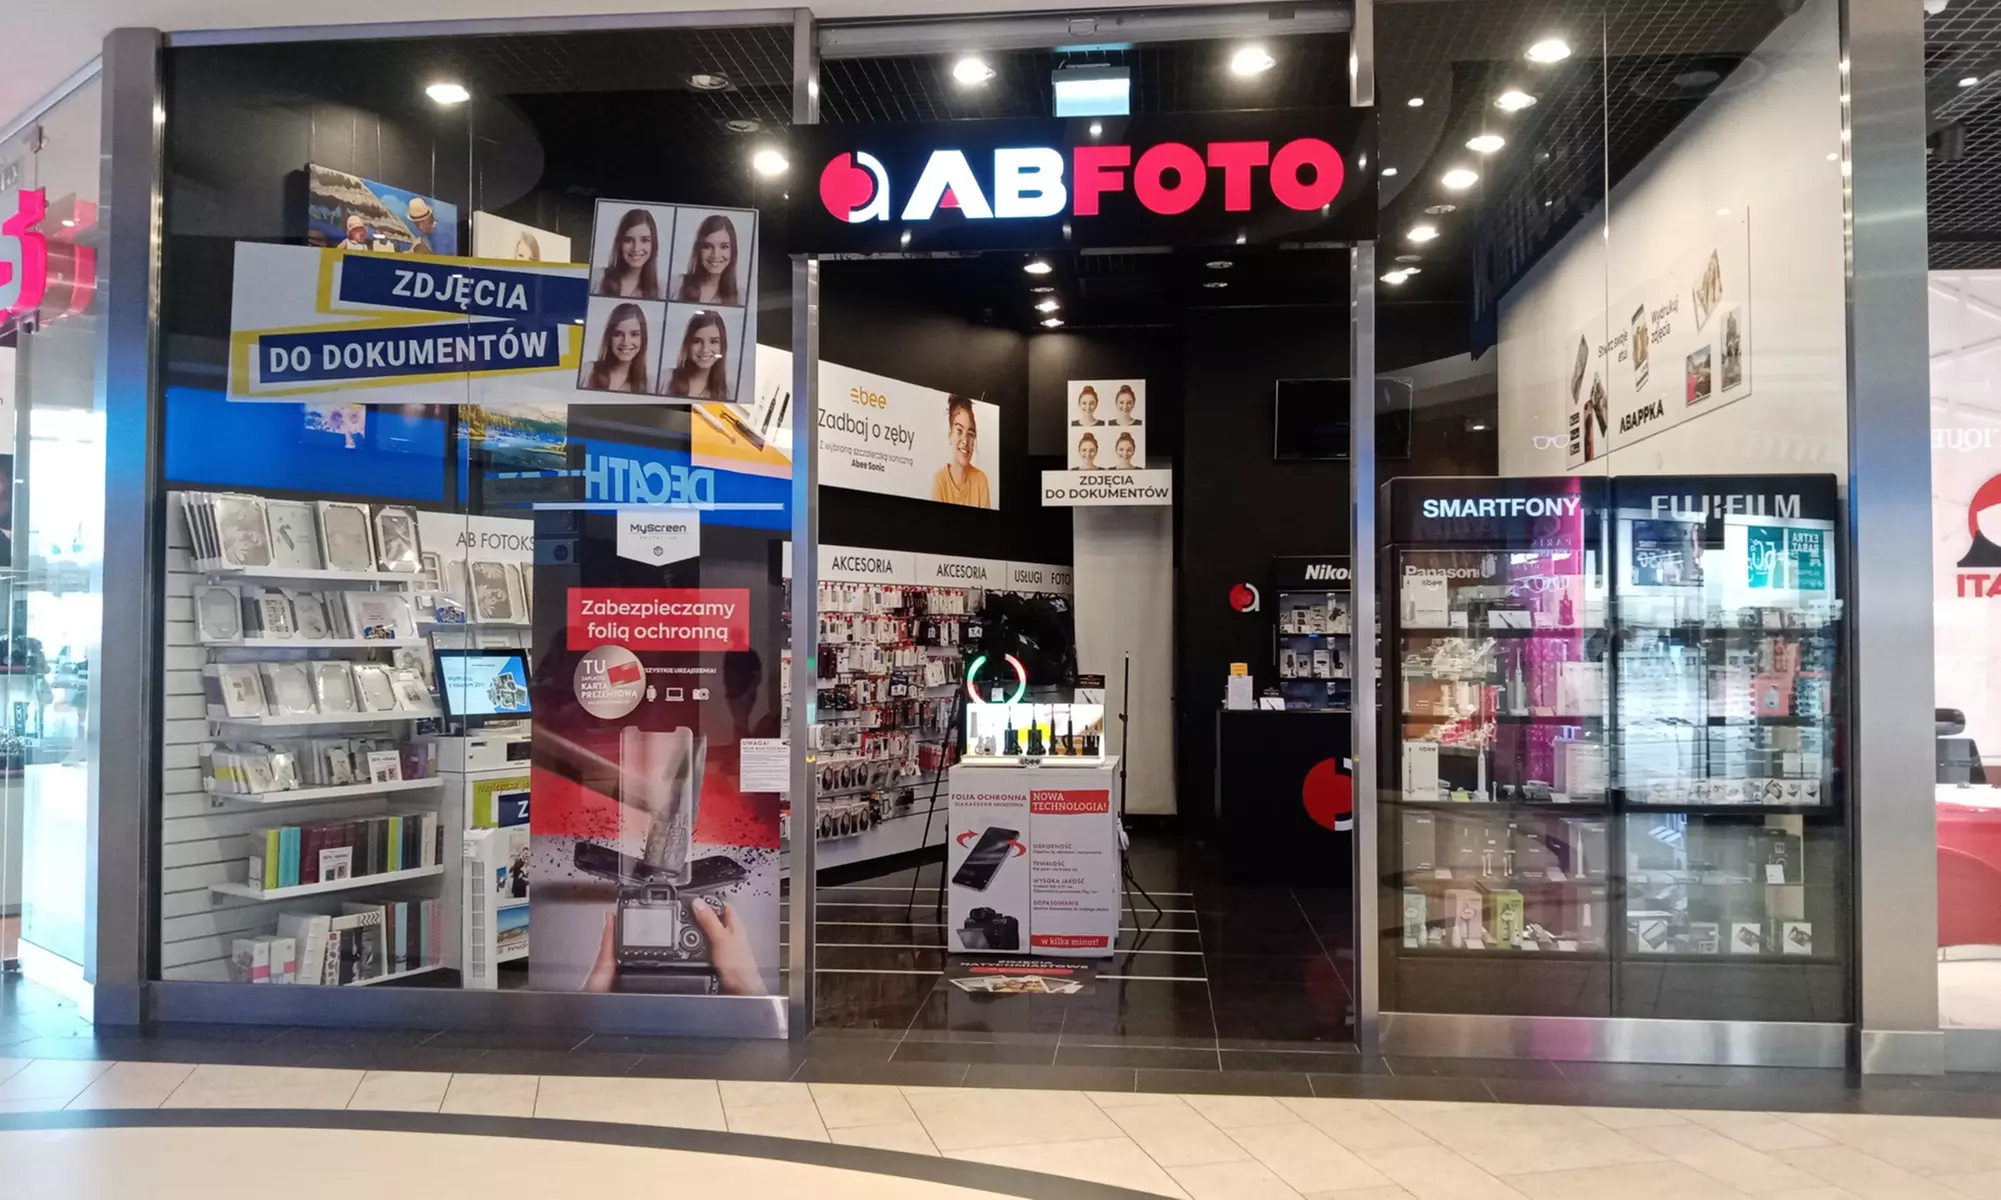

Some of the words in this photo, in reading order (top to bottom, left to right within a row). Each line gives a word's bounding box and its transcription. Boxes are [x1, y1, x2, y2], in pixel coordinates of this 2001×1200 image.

[901, 138, 1344, 220] ABFOTO
[392, 269, 528, 311] ZDJĘCIA
[270, 345, 311, 373] DO
[323, 330, 548, 370] DOKUMENTÓW
[818, 408, 868, 442] Zadbaj
[872, 423, 881, 438] o
[884, 424, 915, 450] zęby
[852, 459, 867, 470] Abee
[869, 461, 885, 472] Sonic
[1079, 475, 1134, 488] ZDJĘCIA
[1045, 488, 1065, 499] DO
[1068, 485, 1169, 499] DOKUMENTÓW
[1422, 498, 1581, 518] SMARTFONY
[1651, 494, 1801, 520] FUJIFILM
[630, 523, 687, 535] MyScreen
[455, 531, 476, 548] AB
[831, 555, 893, 574] AKCESORIA
[936, 563, 987, 580] AKCESORIA
[1014, 569, 1043, 584] USŁUGI
[1051, 571, 1071, 586] FOTO
[581, 599, 735, 618] Zabezpieczamy
[588, 623, 630, 642] folią
[634, 623, 728, 642] ochronną
[583, 660, 606, 674] TU
[478, 780, 519, 795] Najlepsza
[1032, 792, 1064, 801] NOWA
[1032, 801, 1107, 812] TECHNOLOGIA!
[1050, 936, 1069, 945] kilka
[1071, 936, 1099, 946] minut!
